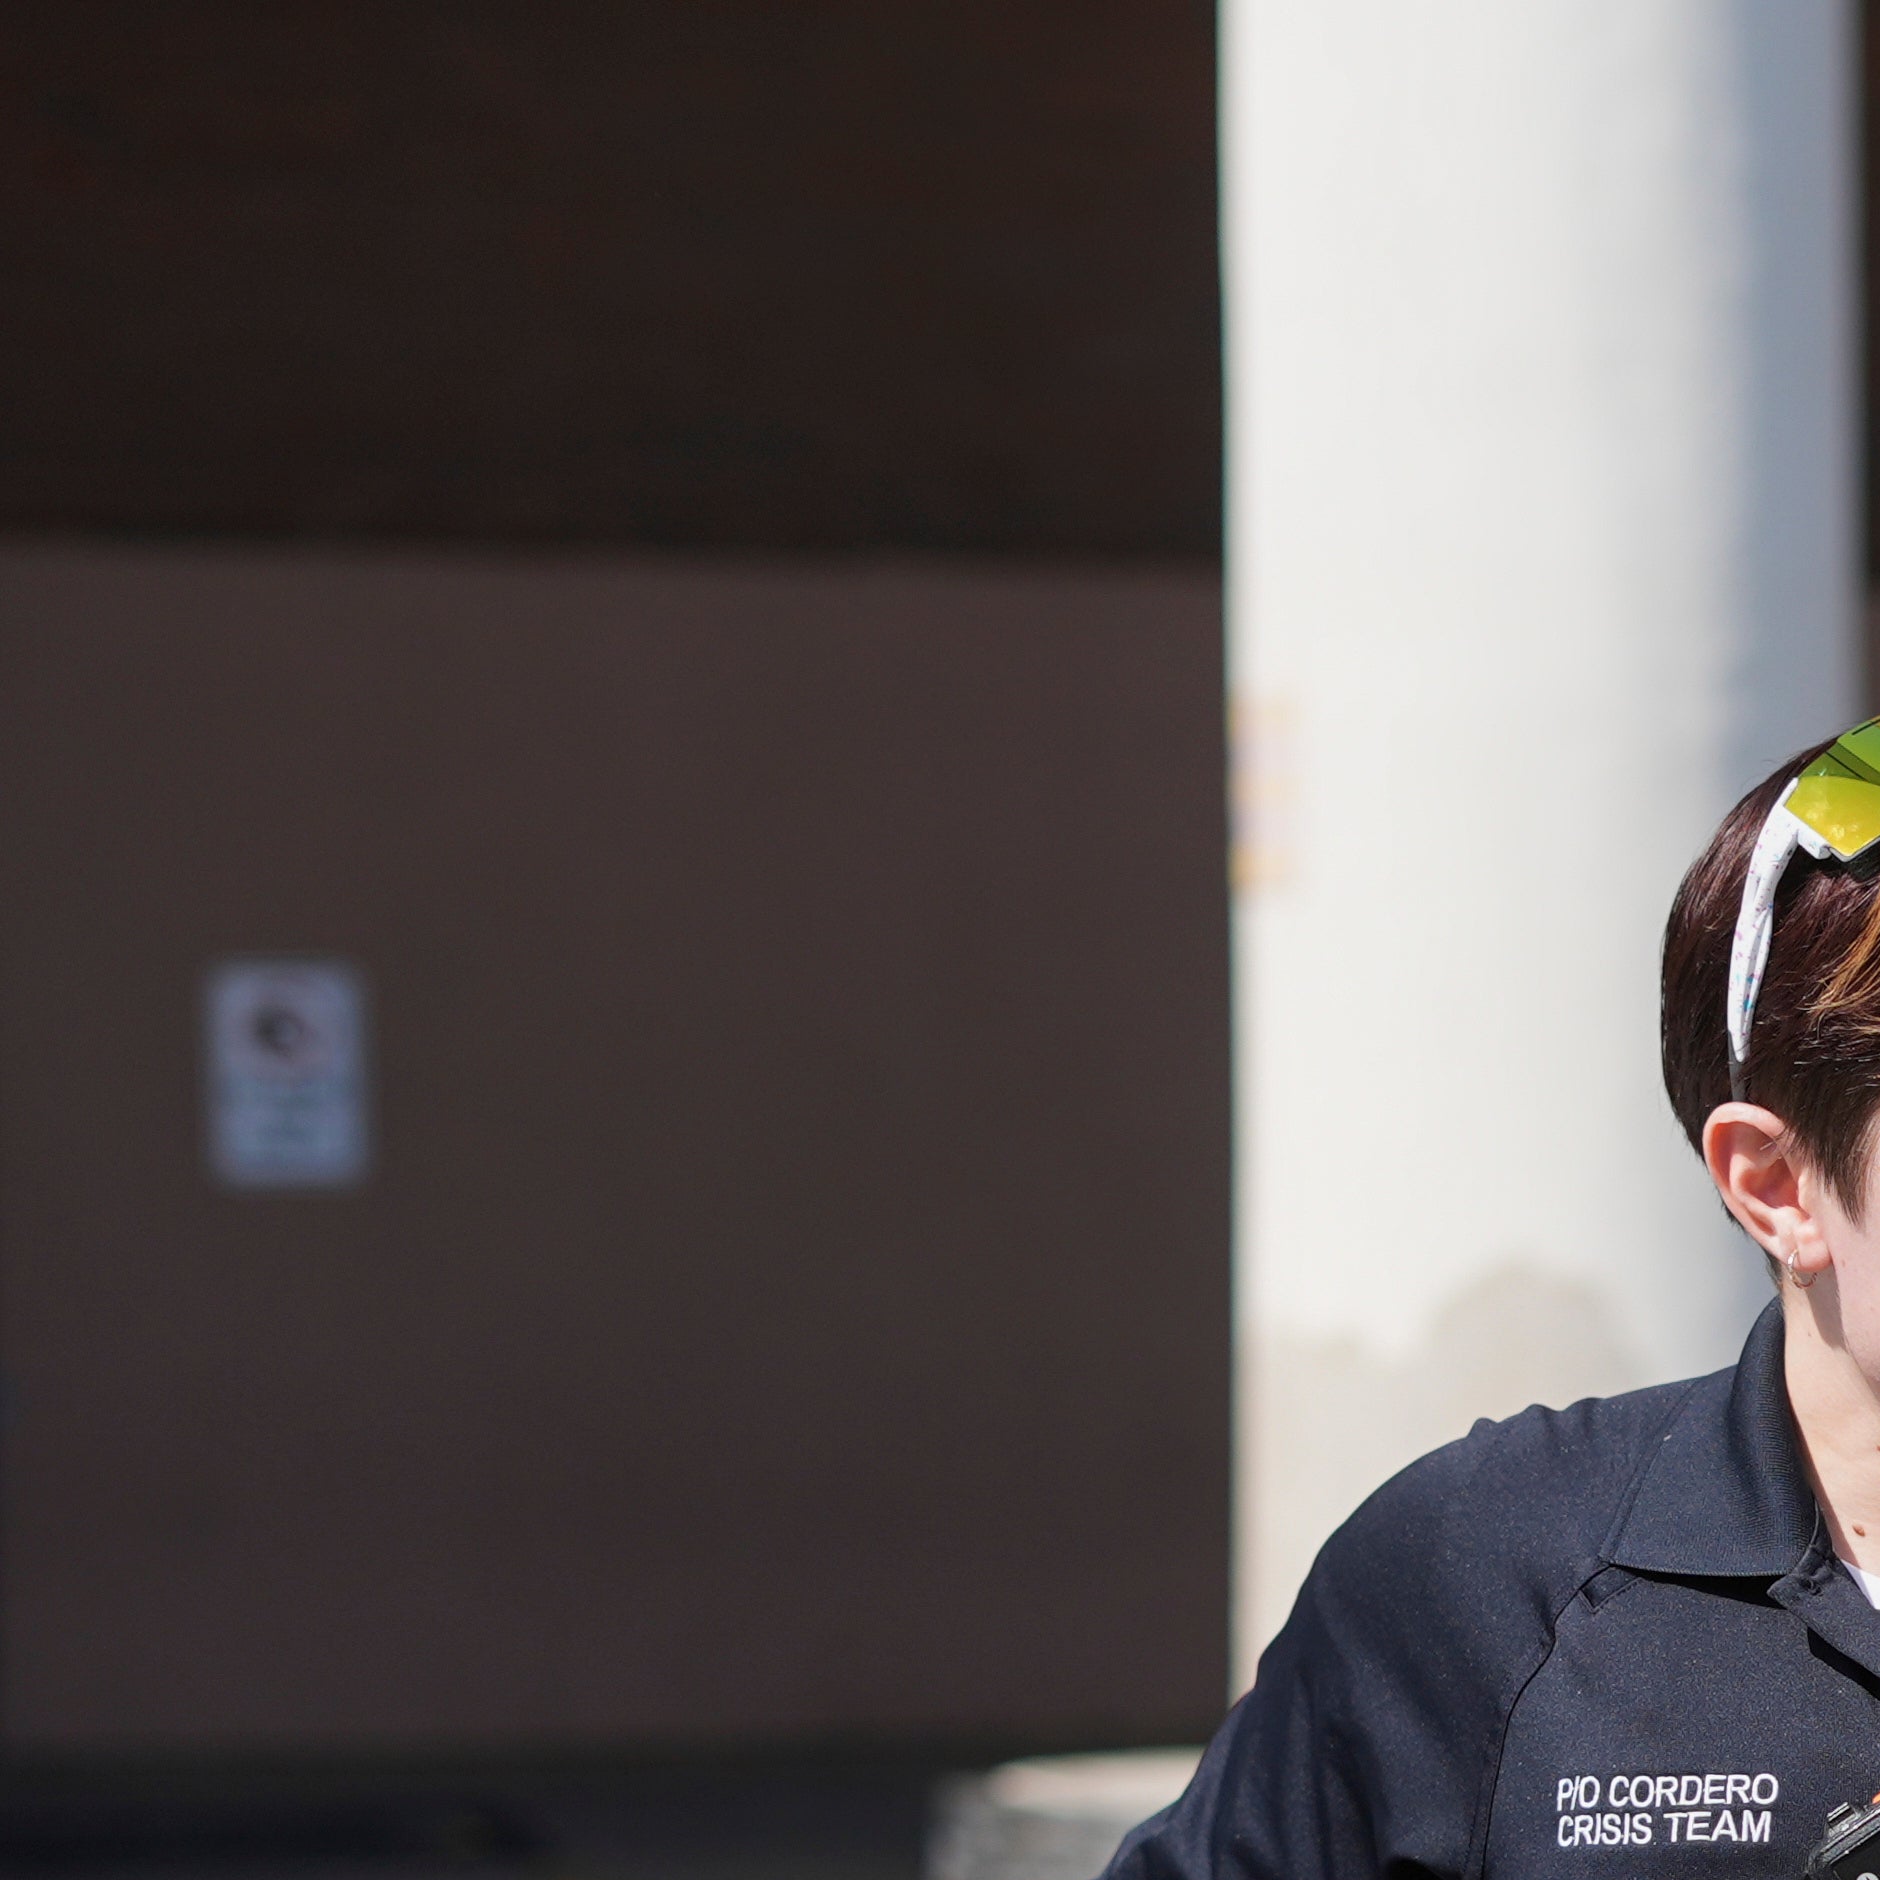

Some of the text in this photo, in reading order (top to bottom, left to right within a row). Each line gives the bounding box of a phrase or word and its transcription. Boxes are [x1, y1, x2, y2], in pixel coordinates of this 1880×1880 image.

[1556, 1773, 1779, 1811] P/O CORDERO
[1557, 1810, 1772, 1847] CRISIS TEAM
